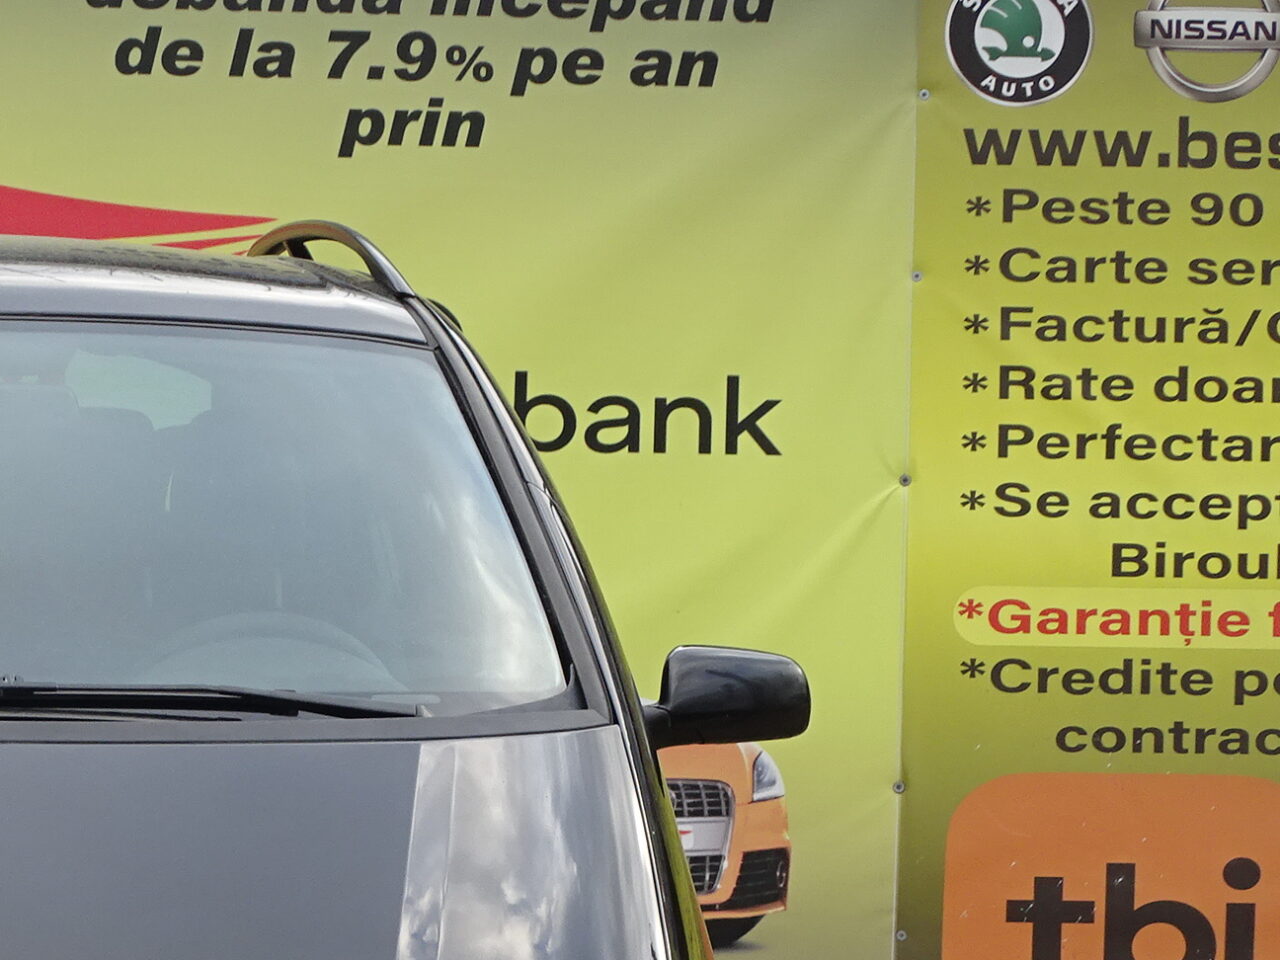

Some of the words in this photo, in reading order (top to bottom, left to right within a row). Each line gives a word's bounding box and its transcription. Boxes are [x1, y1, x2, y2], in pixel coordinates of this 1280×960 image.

[1150, 19, 1276, 41] NISSAN
[115, 26, 204, 76] de
[228, 28, 296, 78] la
[510, 47, 604, 96] pe
[629, 49, 719, 87] an
[980, 75, 1055, 97] AUTO
[337, 97, 485, 157] prin
[1190, 192, 1264, 226] 90
[513, 370, 782, 456] bank
[1088, 490, 1280, 530] accep
[1233, 670, 1280, 705] p
